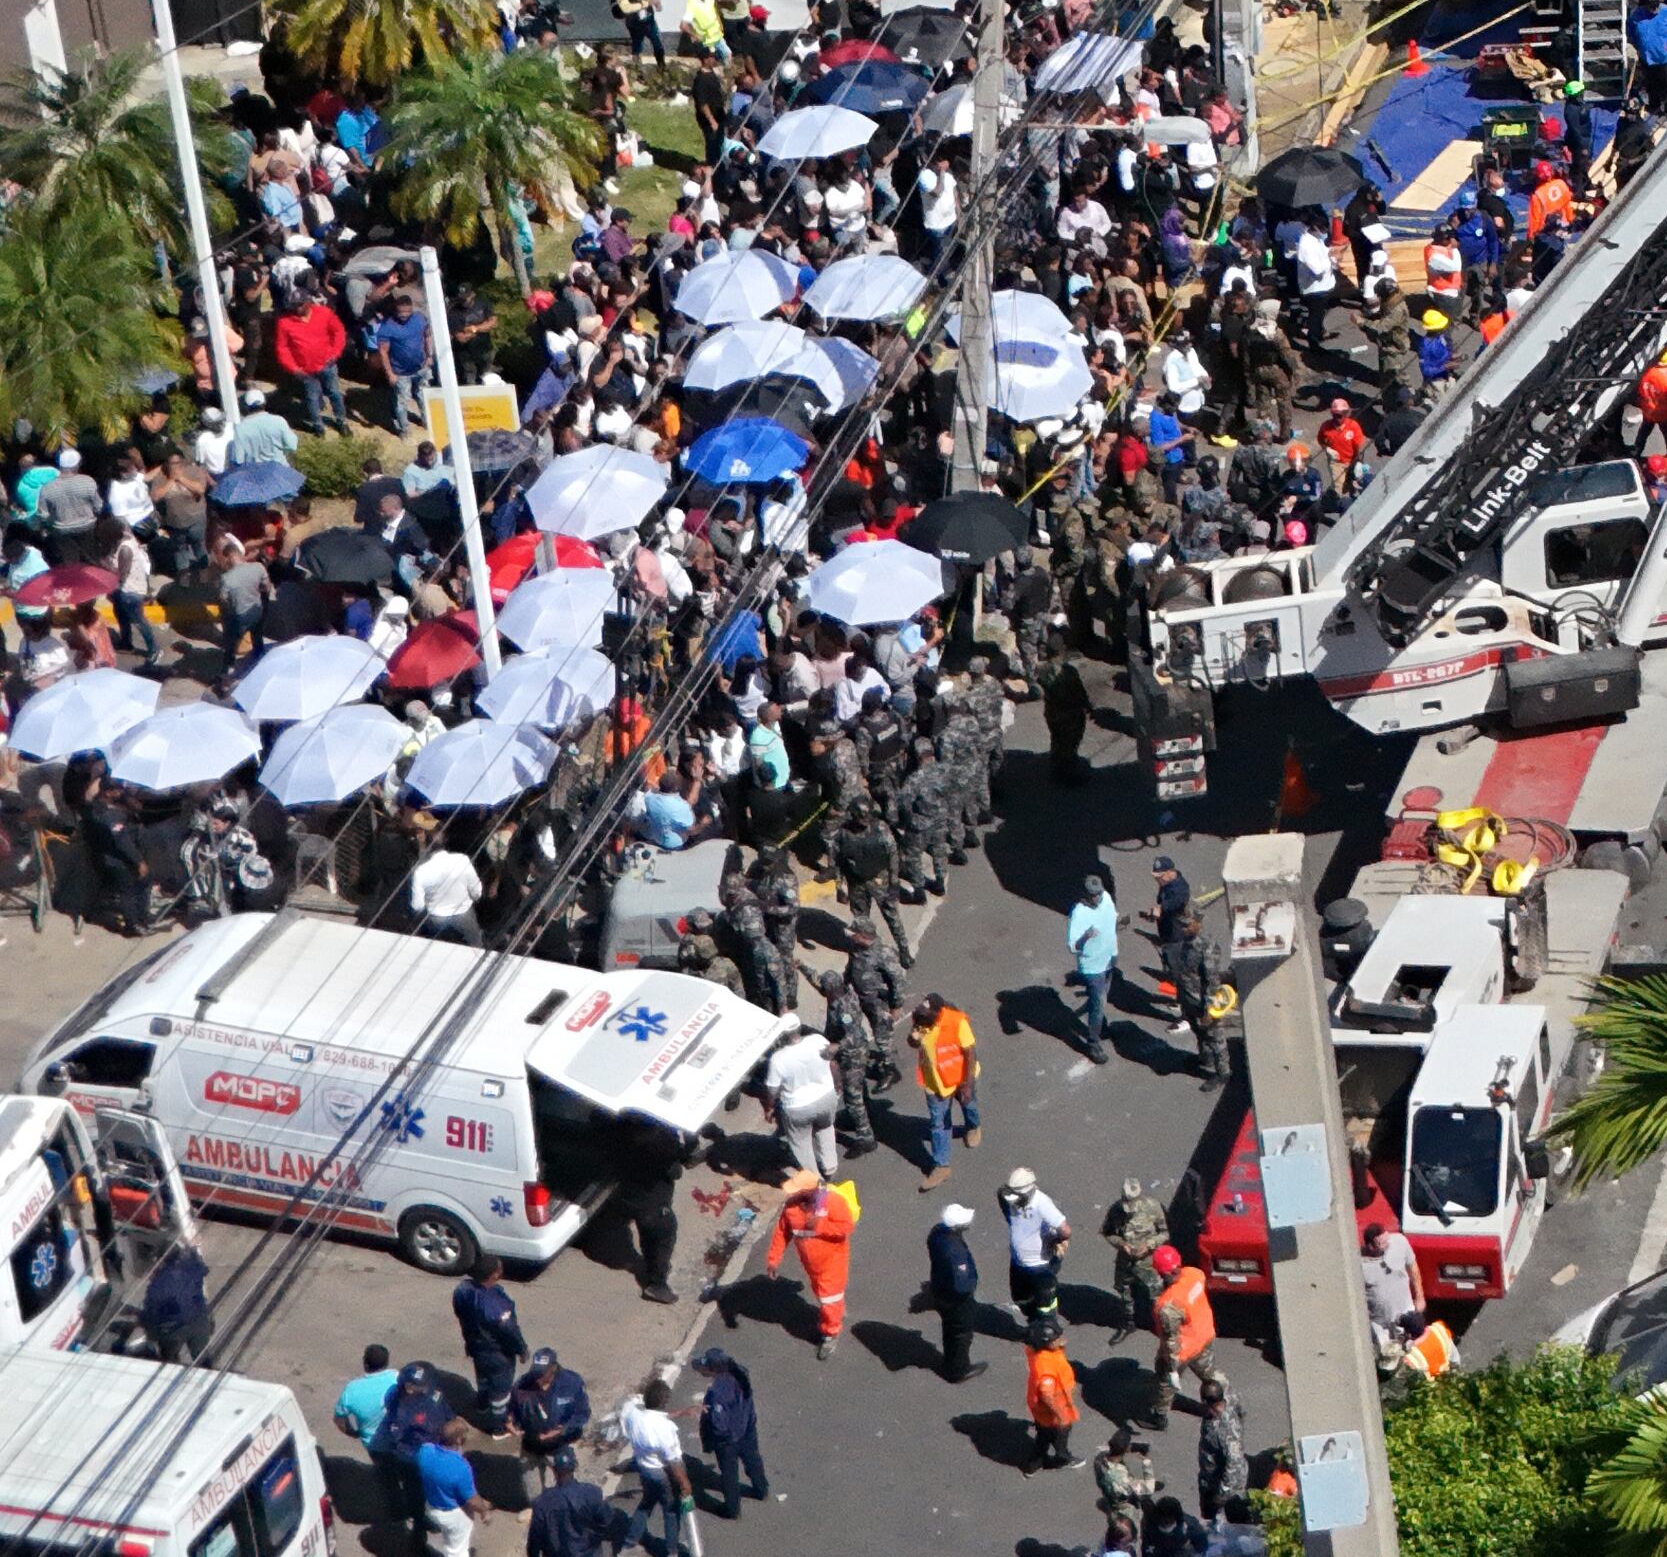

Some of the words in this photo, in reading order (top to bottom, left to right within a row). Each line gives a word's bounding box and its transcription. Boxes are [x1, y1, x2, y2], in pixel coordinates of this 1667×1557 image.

[1461, 439, 1551, 533] Link-Belt
[569, 991, 609, 1028] MOPC
[174, 1022, 258, 1050] ASISTENCIA
[261, 1040, 293, 1056] VIAL
[641, 1001, 721, 1086] AMBULANCIA
[213, 1076, 296, 1107] MOPC
[446, 1115, 488, 1154] 911
[186, 1134, 364, 1192] AMBULANCIA
[190, 1414, 288, 1530] AMBULANCIA
